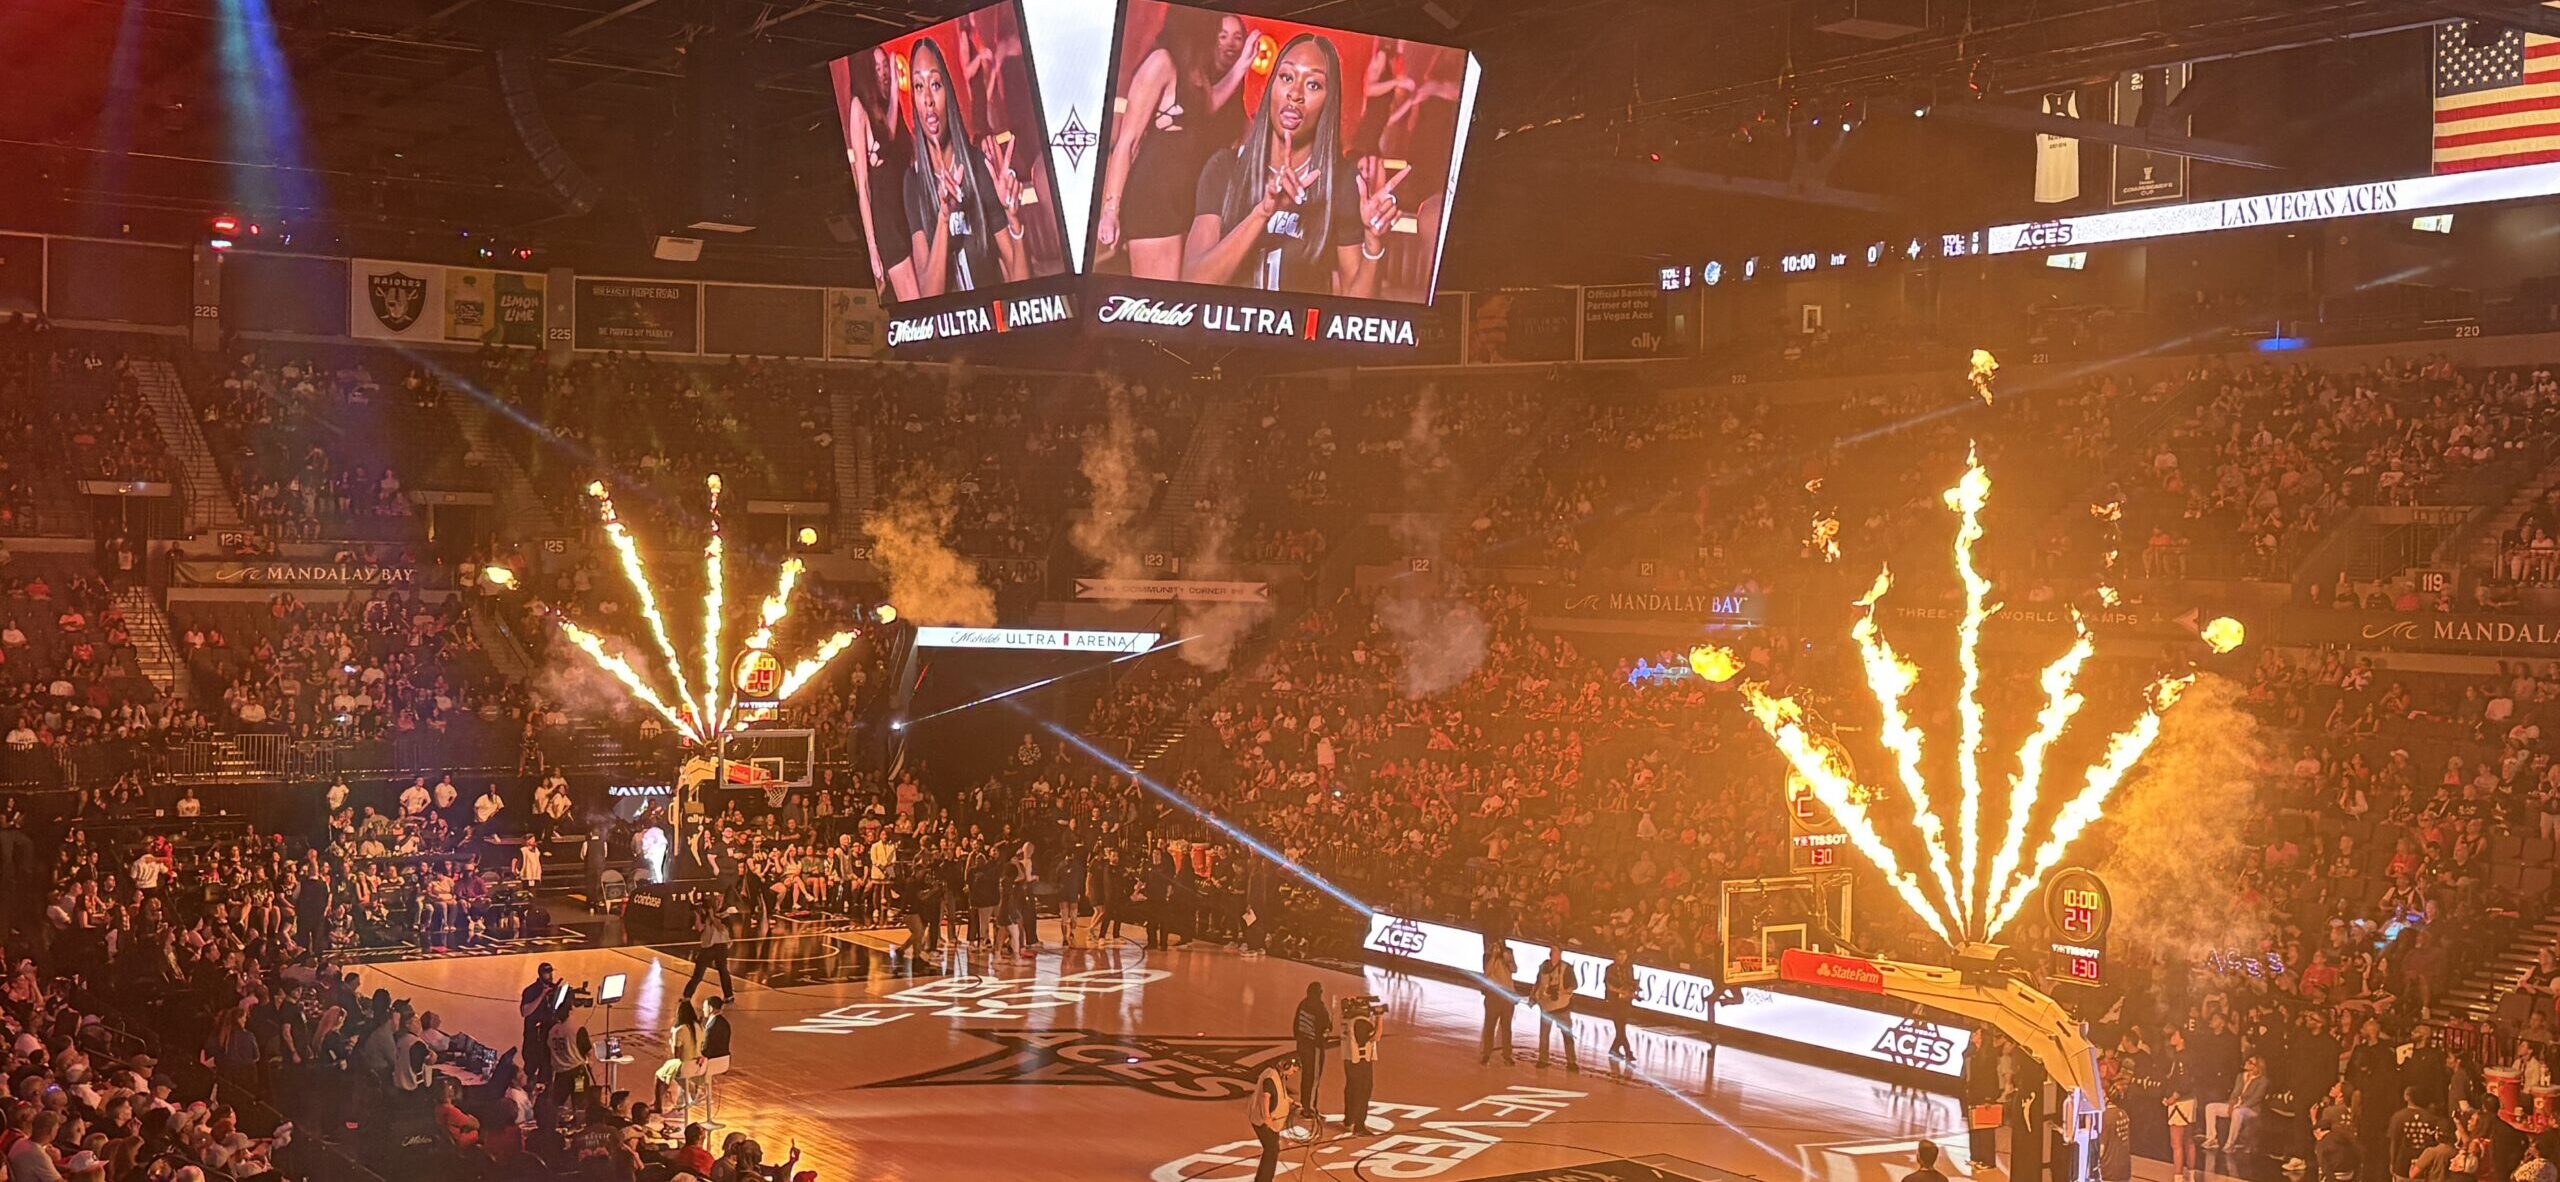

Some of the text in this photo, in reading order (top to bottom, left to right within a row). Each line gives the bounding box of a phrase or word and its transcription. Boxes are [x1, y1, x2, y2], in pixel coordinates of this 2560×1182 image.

[1051, 132, 1097, 147] ACES
[2220, 183, 2397, 226] LAS VEGAS ACES
[2018, 227, 2070, 247] ACES
[1746, 261, 1754, 277] 0
[1781, 254, 1816, 272] 10:00
[1868, 246, 1877, 264] 0
[373, 276, 421, 288] RAIDERS
[500, 294, 539, 308] LEMON
[1587, 288, 1620, 299] Official
[194, 306, 218, 318] 226
[1587, 300, 1649, 310] Partner of the
[504, 309, 535, 322] LIME
[887, 316, 934, 346] Michelob
[936, 307, 991, 337] ULTRA
[1008, 295, 1066, 327] ARENA
[1098, 295, 1414, 345] Michelob ULTRA ARENA
[1586, 311, 1654, 322] Las Vegas Aces
[550, 328, 571, 340] 225
[2455, 325, 2480, 338] 220
[1632, 332, 1661, 352] ally
[2032, 354, 2049, 364] 221
[544, 540, 564, 553] 125
[1144, 554, 1164, 566] 123
[1412, 559, 1430, 571] 122
[268, 567, 413, 580] MANDALAY BAY
[1641, 563, 1654, 576] 121
[2422, 574, 2444, 592] 119
[1609, 593, 1743, 614] MANDALAY BAY
[950, 632, 1126, 646] Michelob ULTRA ARENA
[746, 670, 773, 692] 24
[1808, 834, 1848, 846] TISSOT
[634, 892, 662, 908] coinbase
[2064, 889, 2098, 910] 10:00
[2064, 908, 2092, 933] 24
[1377, 926, 1425, 952] ACES
[2066, 946, 2100, 958] TISSOT
[2072, 958, 2097, 978] 1:30
[1656, 978, 1710, 1014] ACES
[771, 975, 1038, 1034] NEVER
[1877, 1030, 1951, 1063] ACES
[992, 1032, 1257, 1098] ACES
[1315, 1085, 1589, 1179] NEVER
